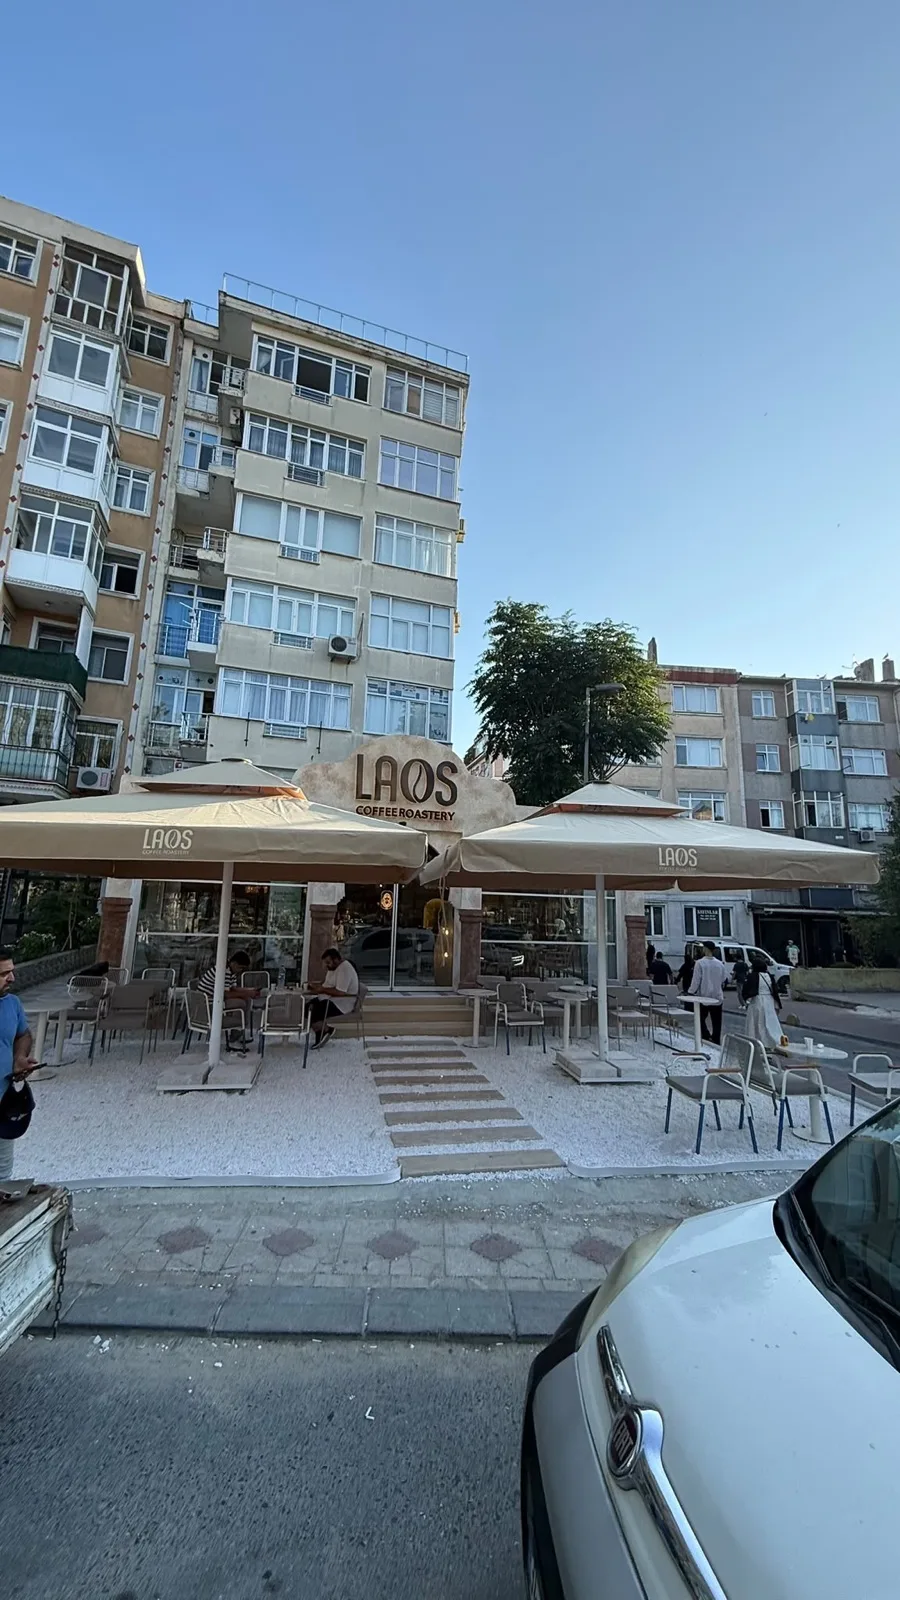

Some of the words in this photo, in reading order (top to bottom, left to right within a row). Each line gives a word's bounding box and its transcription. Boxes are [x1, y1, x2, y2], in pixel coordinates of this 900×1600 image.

[355, 754, 458, 806] LAOS
[355, 805, 397, 817] COFFEE
[399, 808, 455, 821] ROASTERY
[143, 829, 194, 850] LAOS
[658, 847, 698, 867] LAOS
